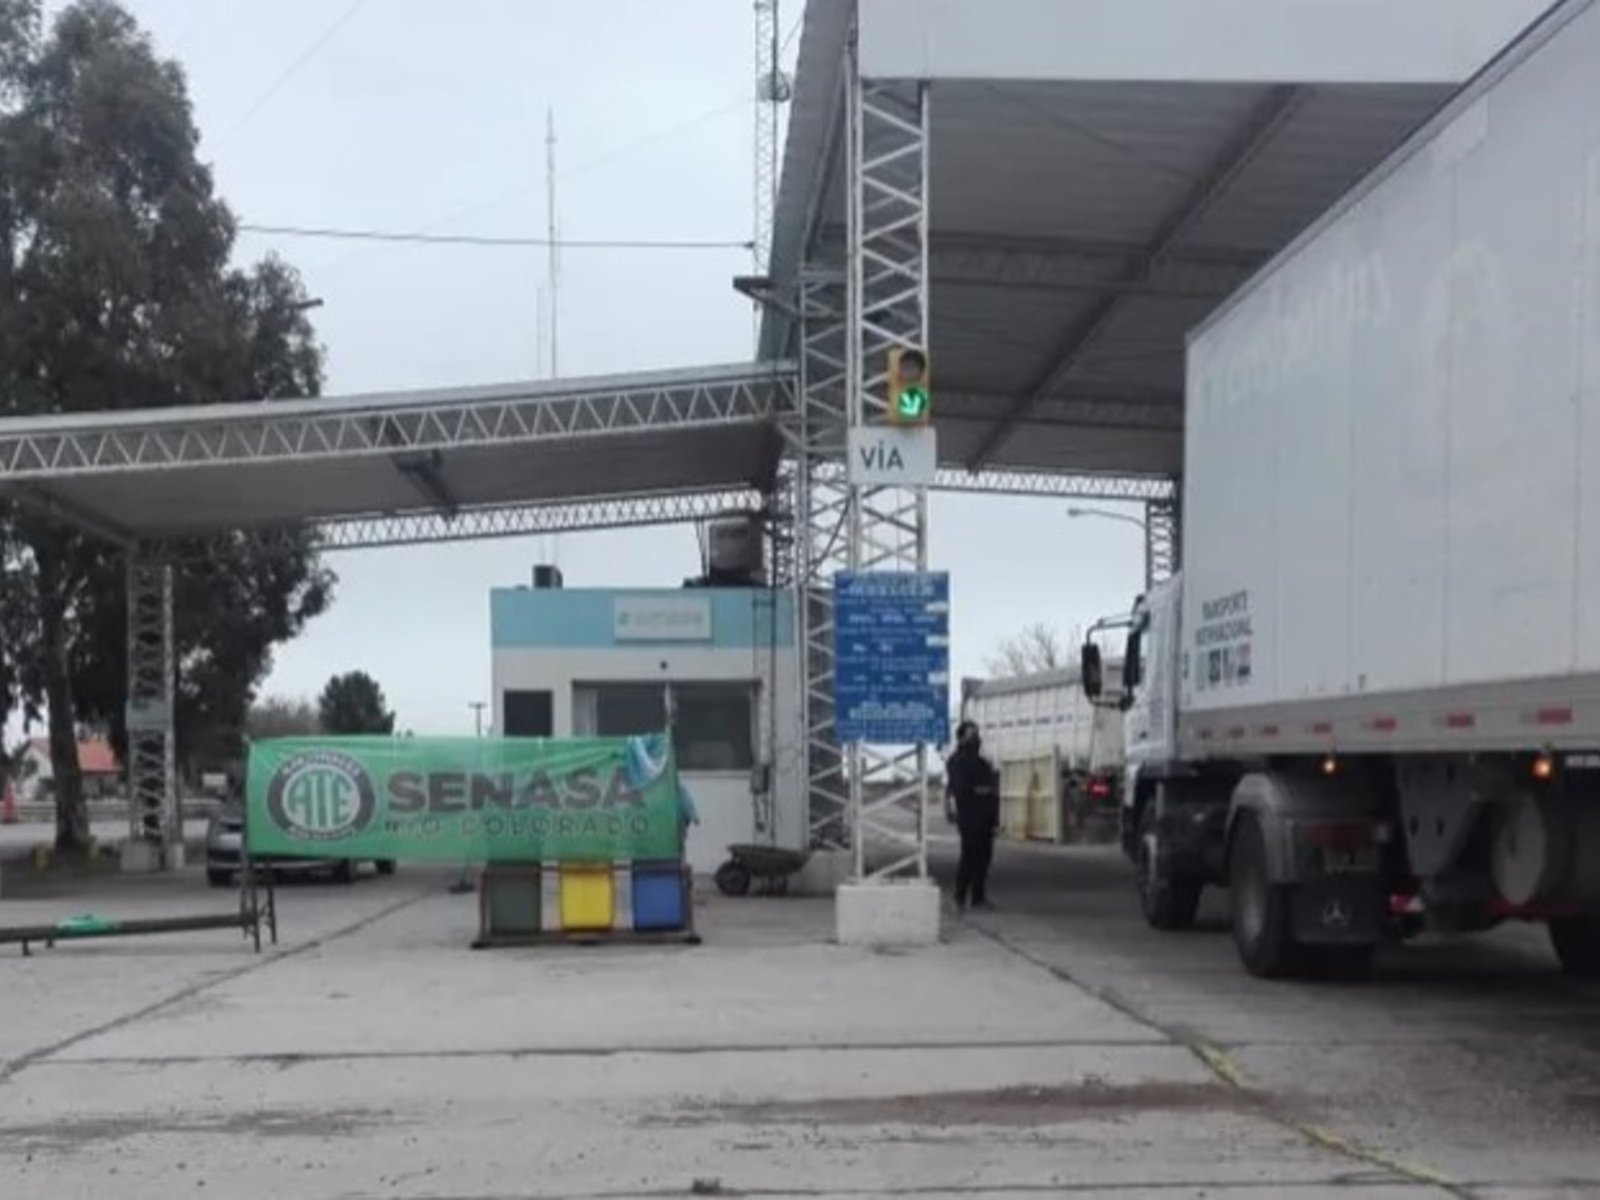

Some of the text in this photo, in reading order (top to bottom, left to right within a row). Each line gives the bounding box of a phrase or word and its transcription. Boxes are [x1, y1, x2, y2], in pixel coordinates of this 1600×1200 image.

[286, 770, 356, 830] ATE
[387, 768, 645, 812] SENASA
[461, 815, 649, 836] COLORADO
